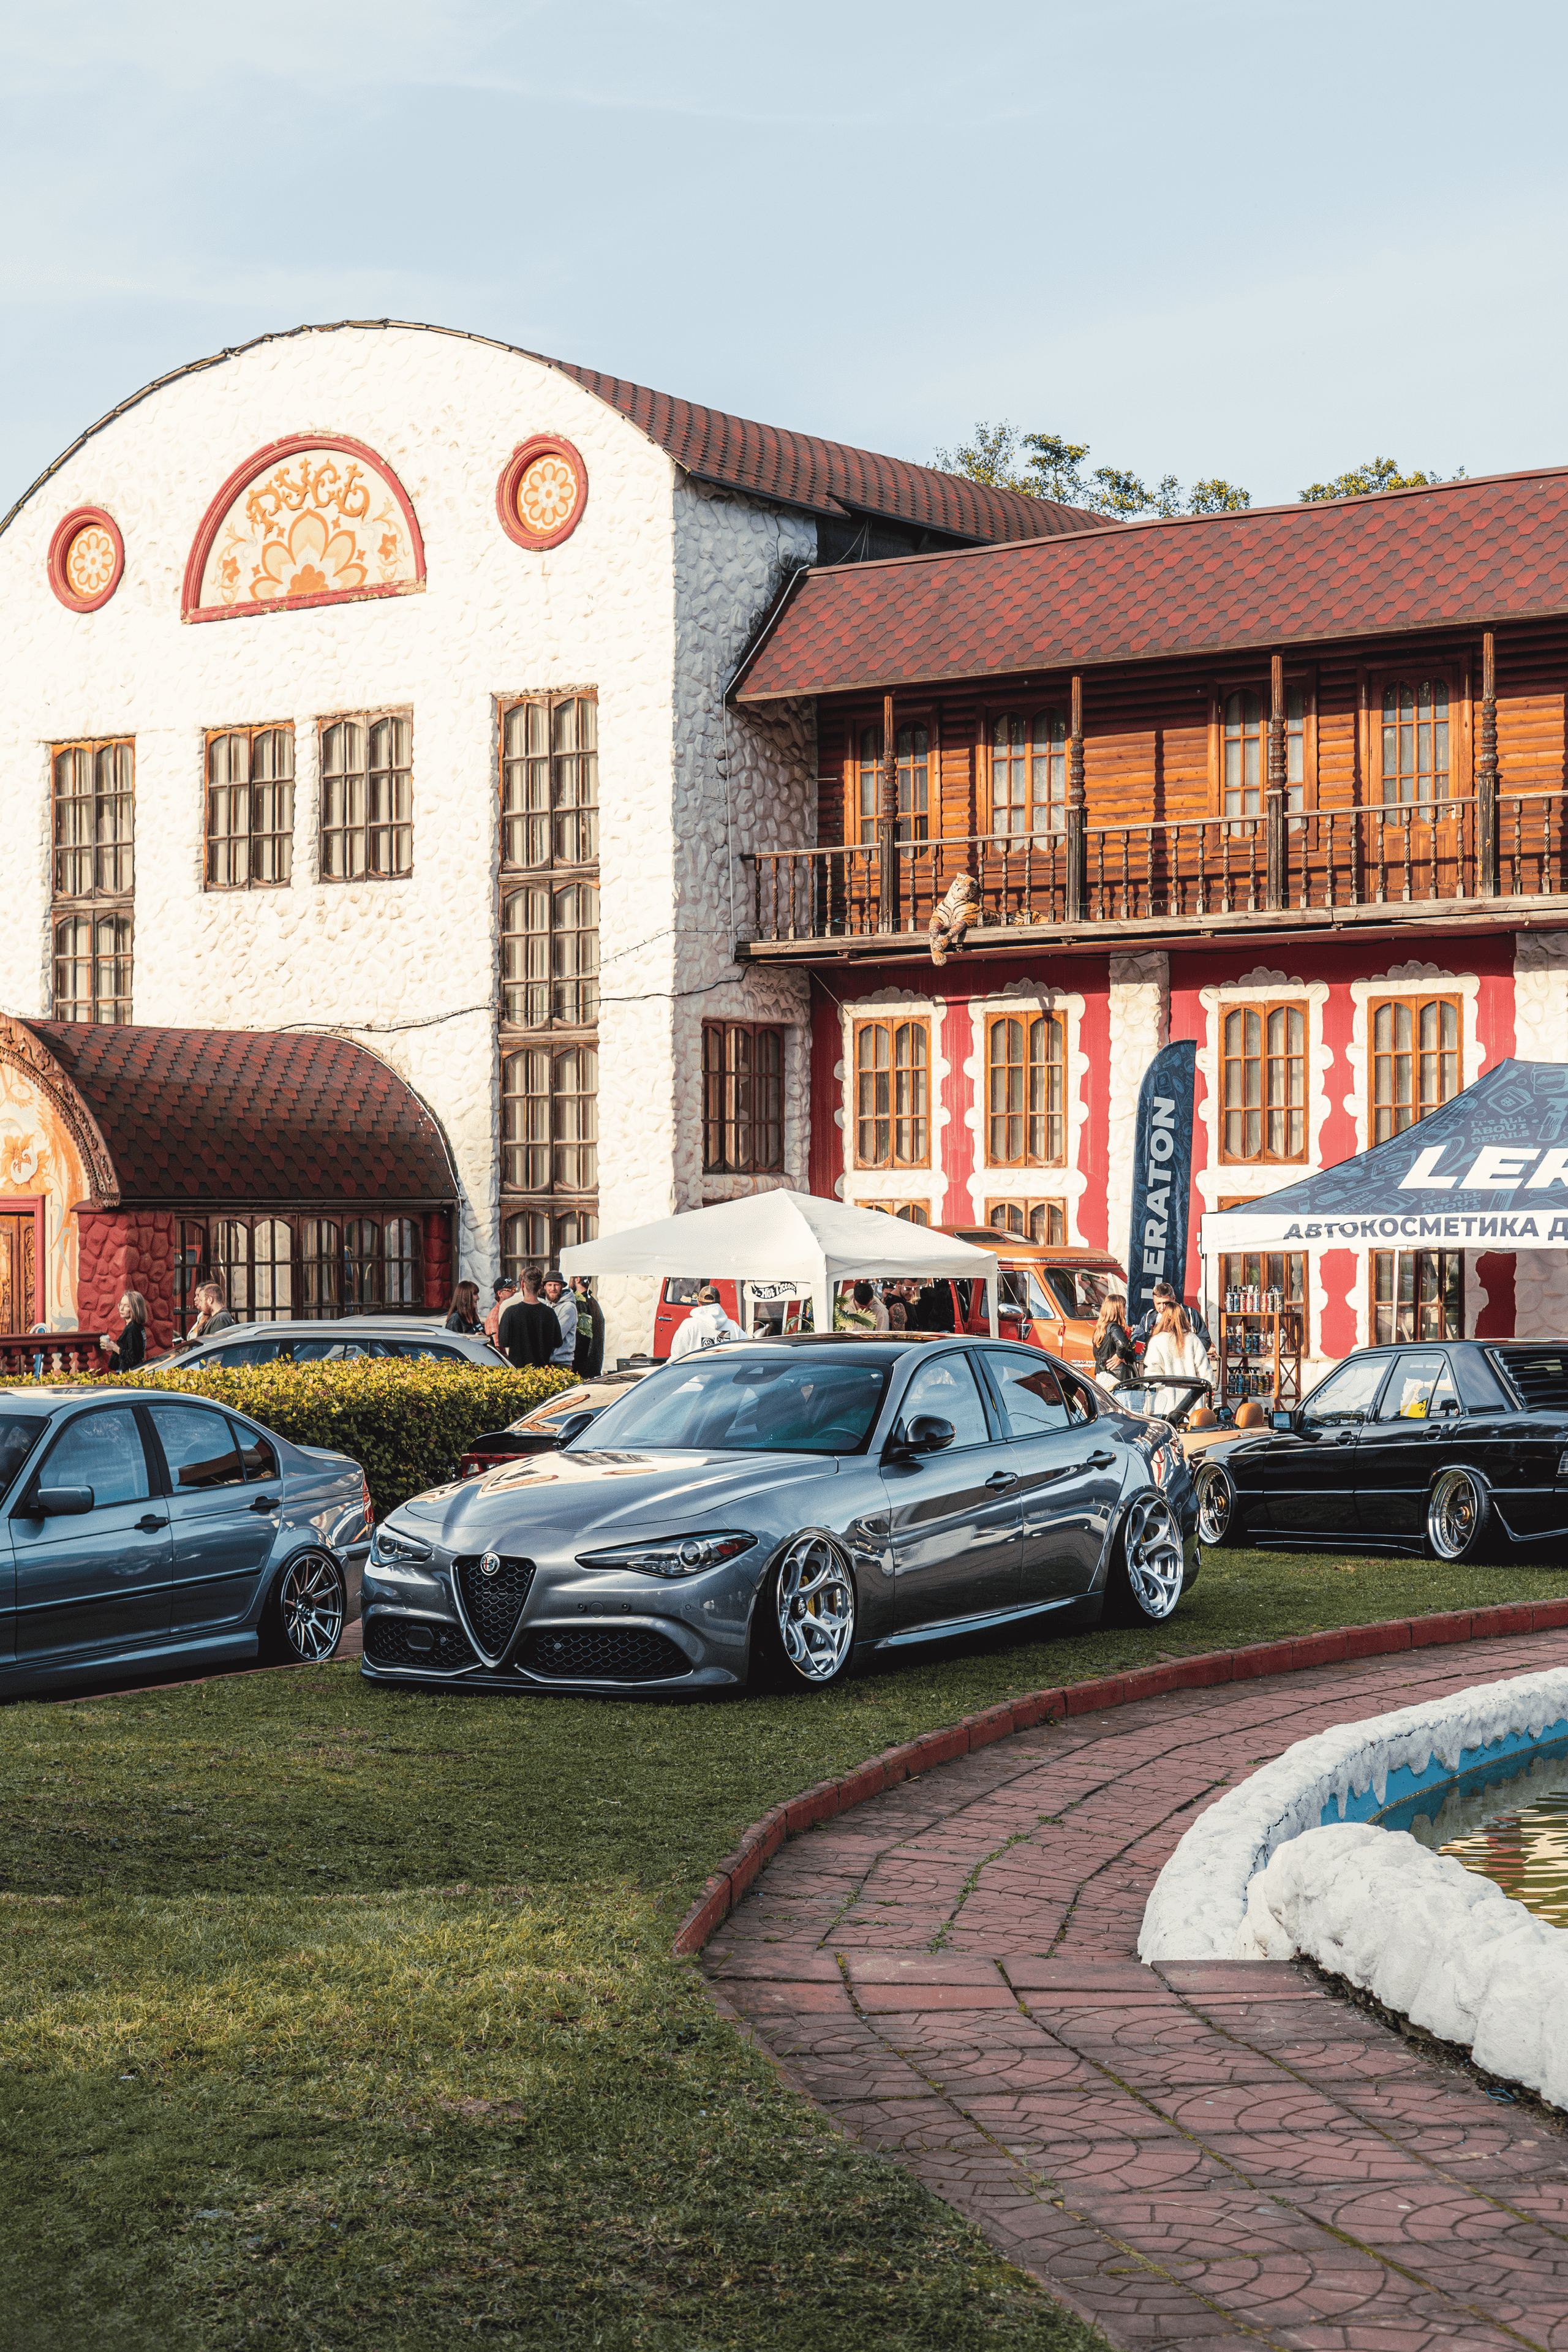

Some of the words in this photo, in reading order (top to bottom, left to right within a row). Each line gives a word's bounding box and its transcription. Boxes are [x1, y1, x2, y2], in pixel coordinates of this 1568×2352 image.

[1471, 1123, 1526, 1136] ABOUT
[1471, 1130, 1529, 1144] DETAILS
[1141, 1096, 1175, 1299] LERATON
[1422, 1197, 1449, 1208] IT'S
[1453, 1191, 1481, 1201] ALL
[1422, 1197, 1481, 1215] ABOUT
[1283, 1217, 1539, 1240] АВТОКОСМЕТИКА
